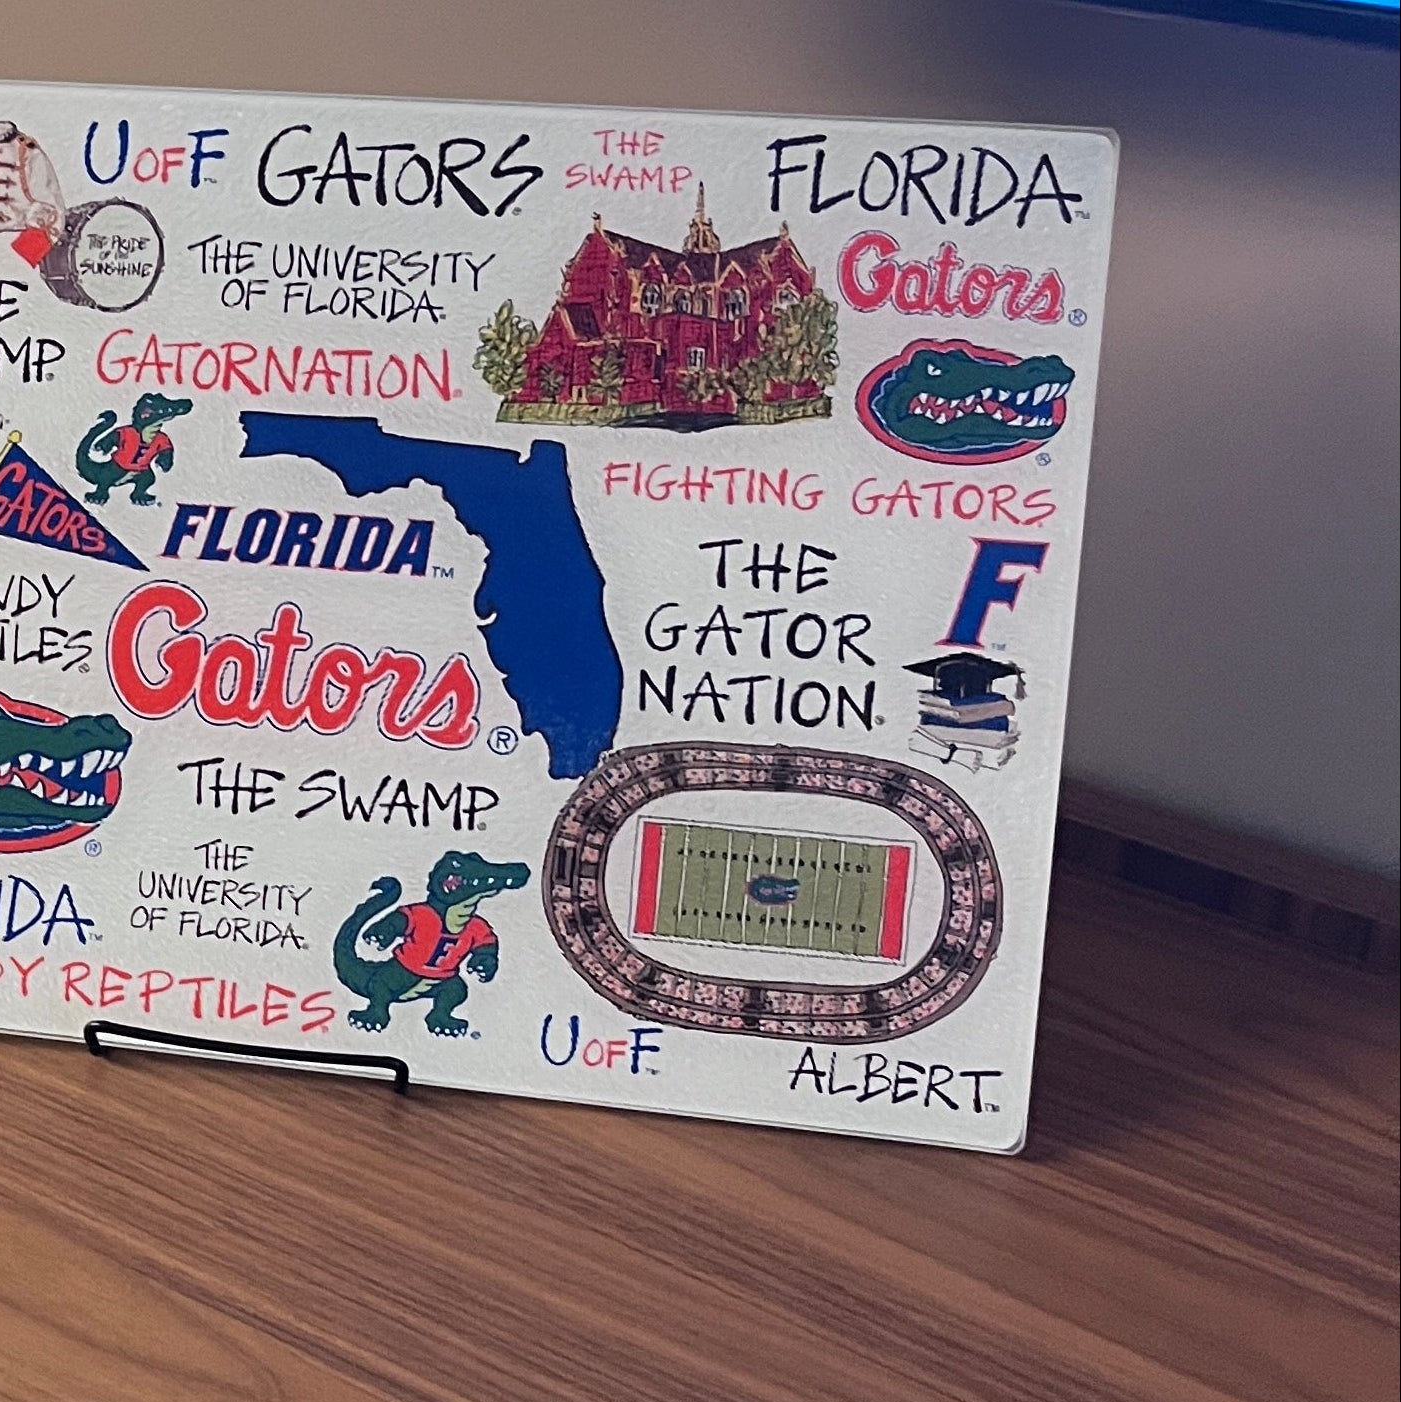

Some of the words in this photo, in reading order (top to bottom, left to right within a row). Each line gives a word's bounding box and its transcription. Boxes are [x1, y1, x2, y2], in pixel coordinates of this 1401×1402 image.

[257, 124, 544, 217] GATORS
[592, 129, 666, 158] THE
[564, 162, 693, 196] SWAMP
[767, 134, 1084, 229] FLORIDA
[187, 234, 263, 275] THE
[271, 242, 496, 292] UNIVERSITY
[837, 229, 1067, 325] Gators
[220, 278, 270, 312] OF
[282, 282, 444, 324] FLORIDA
[95, 328, 452, 401] GATORNATION
[603, 461, 824, 511] FIGHTING
[852, 476, 1057, 526] GATORS
[158, 502, 435, 577] FLORIDA
[699, 538, 837, 593] THE
[934, 535, 1052, 651] F
[106, 579, 481, 751] Gators
[644, 602, 875, 667] GATOR
[637, 663, 877, 731] NATION
[176, 756, 287, 816] THE
[294, 768, 500, 832] SWAMP
[194, 838, 255, 873] THE
[130, 904, 168, 932] OF
[178, 910, 306, 950] FLORIDA
[137, 870, 314, 917] UNIVERSITY
[61, 961, 336, 1034] REPTILES
[788, 1045, 1003, 1115] ALBERT
